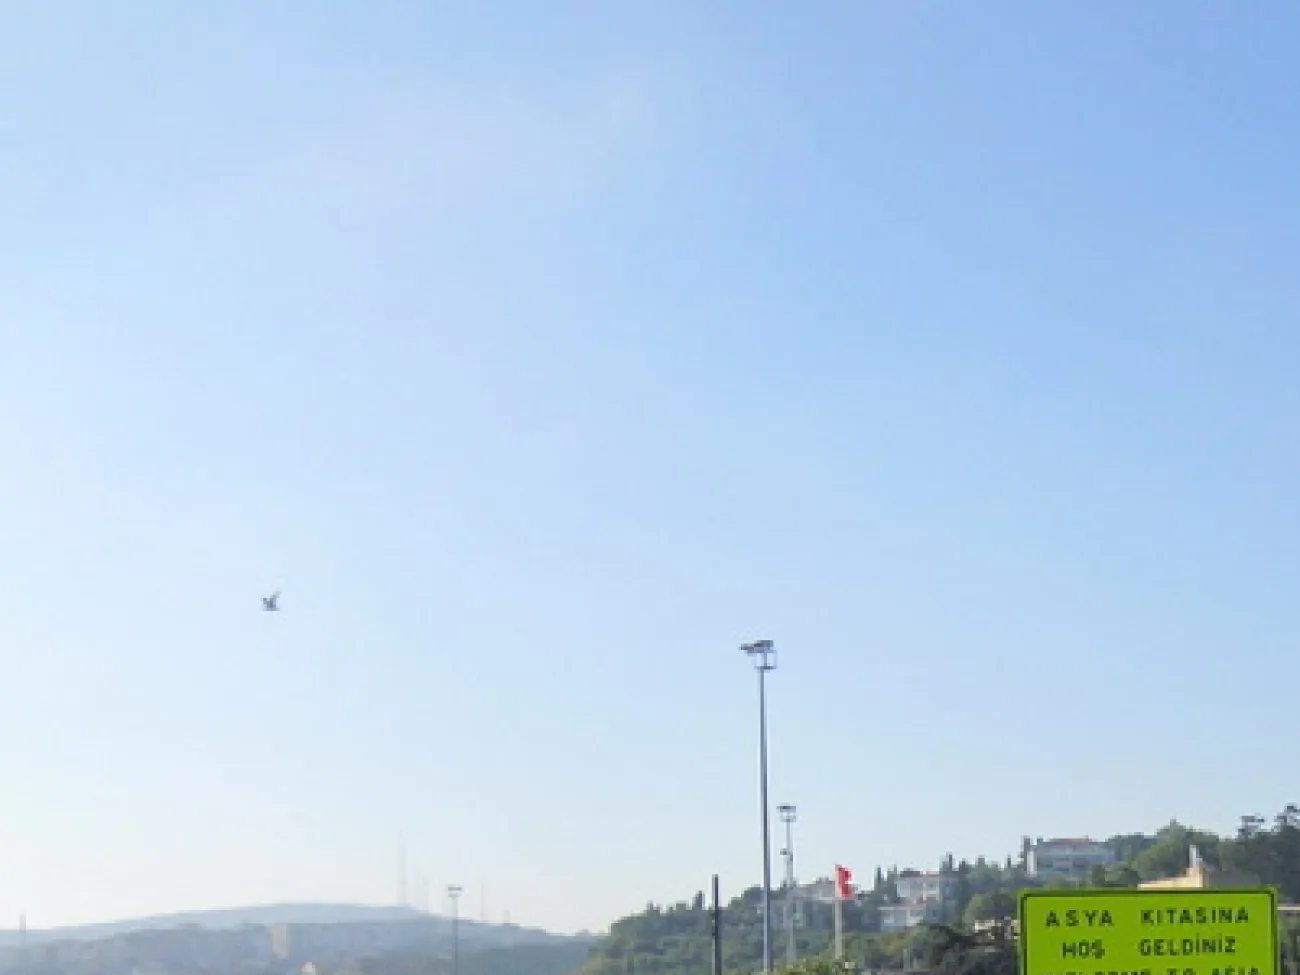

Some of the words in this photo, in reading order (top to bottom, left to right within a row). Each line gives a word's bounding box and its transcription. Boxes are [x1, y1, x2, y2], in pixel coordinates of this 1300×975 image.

[1045, 909, 1115, 927] ASYA
[1140, 906, 1249, 926] KITASINA
[1061, 938, 1106, 959] HOŞ
[1138, 933, 1237, 956] GELDİNİZ
